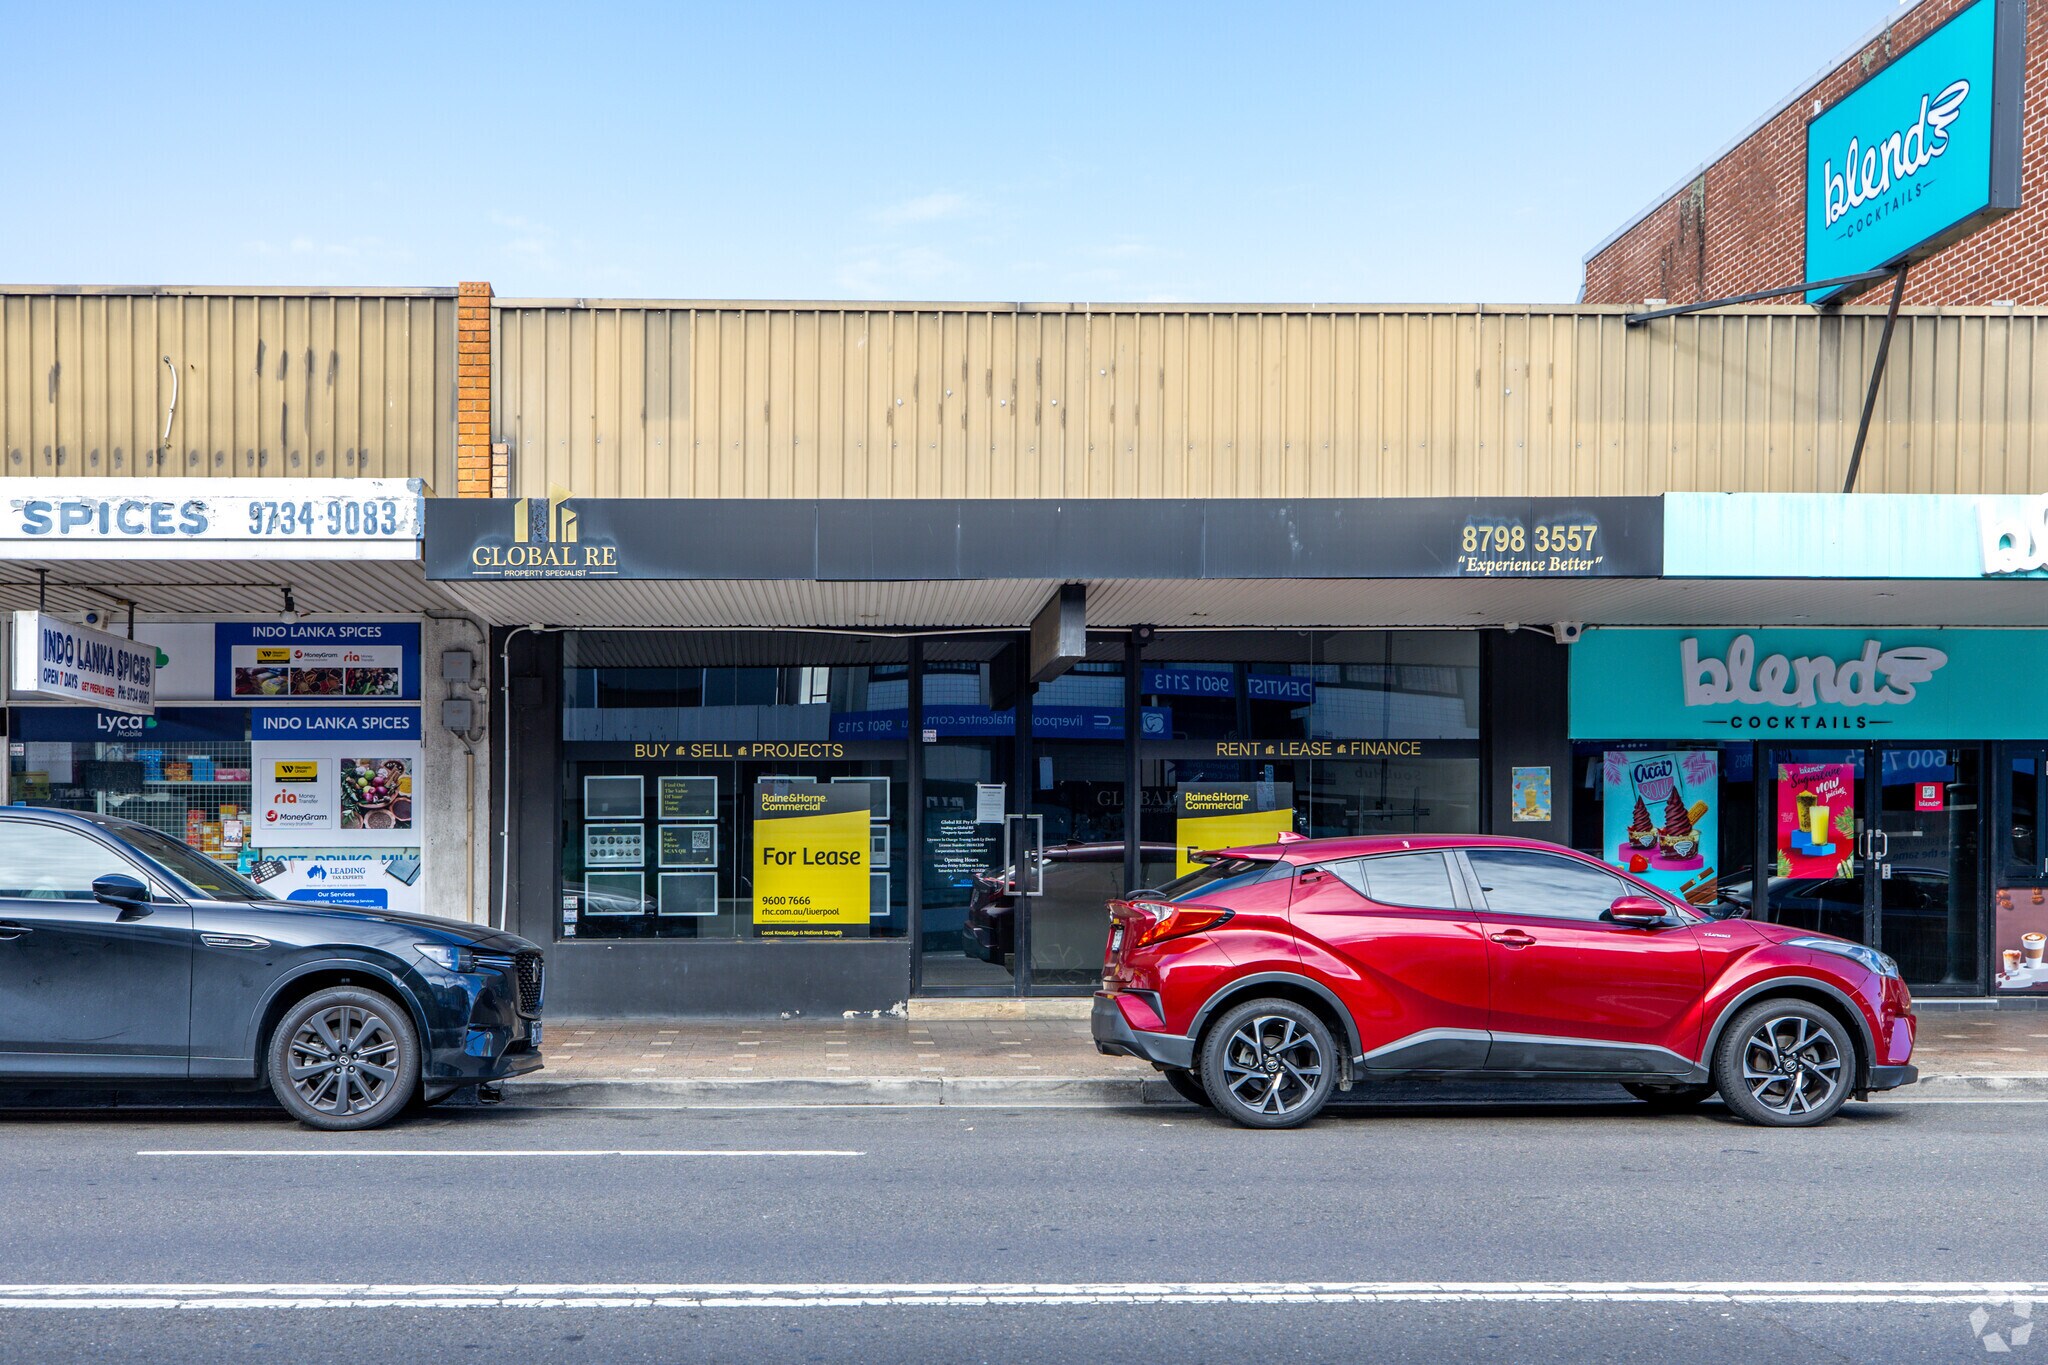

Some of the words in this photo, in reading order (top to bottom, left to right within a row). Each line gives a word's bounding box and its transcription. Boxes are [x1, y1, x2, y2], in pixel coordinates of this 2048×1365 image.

[1823, 78, 1971, 231] blends
[1846, 182, 1922, 239] COCKTAILS
[21, 500, 210, 535] SPICES
[1462, 525, 1526, 553] 8798
[1534, 525, 1599, 553] 3557
[472, 546, 577, 567] GLOBAL
[584, 546, 617, 567] RE
[504, 569, 543, 577] PROPERTY
[545, 569, 587, 577] SPECIALIST
[252, 626, 287, 638] INDO
[290, 626, 336, 638] LANKA
[338, 626, 382, 638] SPICES
[43, 628, 74, 668] INDO
[77, 638, 115, 678] LANKA
[117, 649, 151, 687] SPICES
[343, 651, 360, 662] ria
[1680, 634, 1948, 708] blends
[43, 667, 59, 685] OPEN
[59, 671, 64, 686] 7
[64, 672, 79, 690] DAYS
[81, 681, 90, 692] GET
[97, 713, 143, 733] Lyca
[263, 717, 302, 730] INDO
[306, 717, 358, 730] LANKA
[361, 717, 410, 730] SPICES
[1731, 716, 1867, 729] COCKTAILS
[117, 730, 143, 738] Mobile
[634, 743, 670, 758] BUY
[690, 743, 733, 758] SELL
[752, 743, 844, 758] PROJECTS
[1216, 742, 1261, 757] RENT
[1280, 742, 1333, 757] LEASE
[1351, 741, 1422, 756] FINANCE
[274, 788, 297, 804] ria
[761, 802, 821, 811] Commercial
[1185, 800, 1244, 810] Commercial
[280, 813, 328, 821] MoneyGram
[763, 847, 797, 865] For
[803, 847, 861, 865] Lease
[329, 867, 366, 875] LEADING
[762, 896, 787, 905] 9600
[788, 896, 811, 905] 7666
[761, 907, 840, 917] rhc.com.au/liverpool
